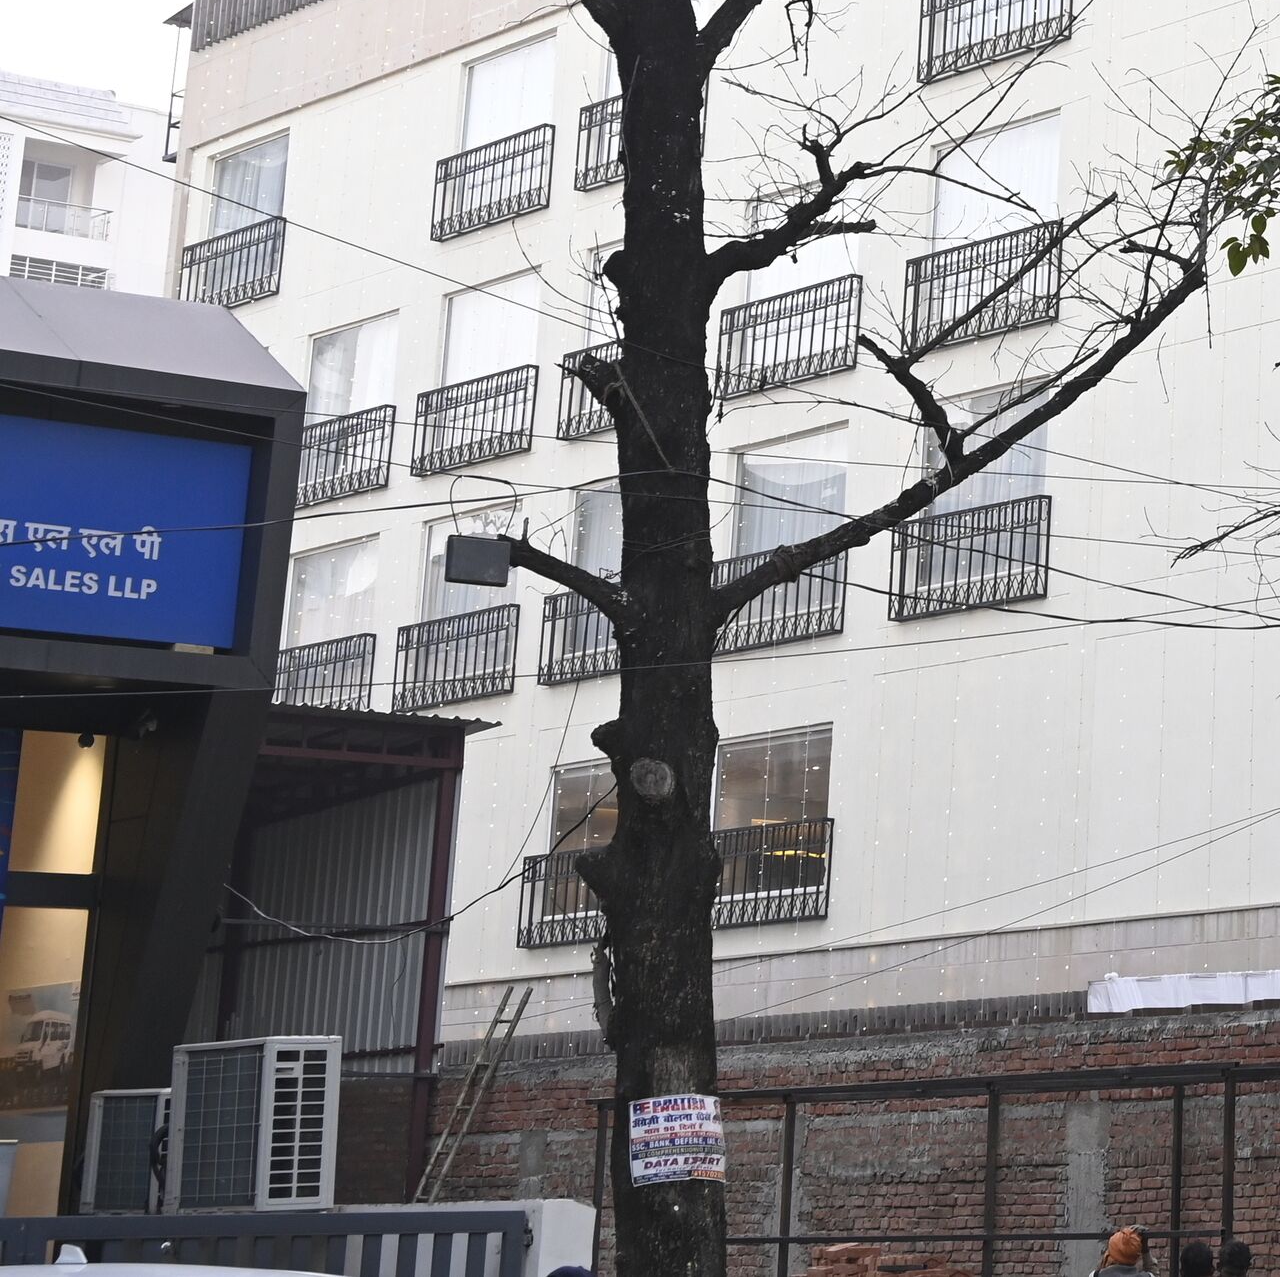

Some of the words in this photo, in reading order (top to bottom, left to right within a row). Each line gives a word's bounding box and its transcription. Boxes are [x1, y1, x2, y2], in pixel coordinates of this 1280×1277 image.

[25, 522, 71, 552] एल
[79, 528, 124, 558] एल
[133, 525, 162, 560] पी
[9, 565, 99, 595] SALES
[107, 575, 158, 600] LLP
